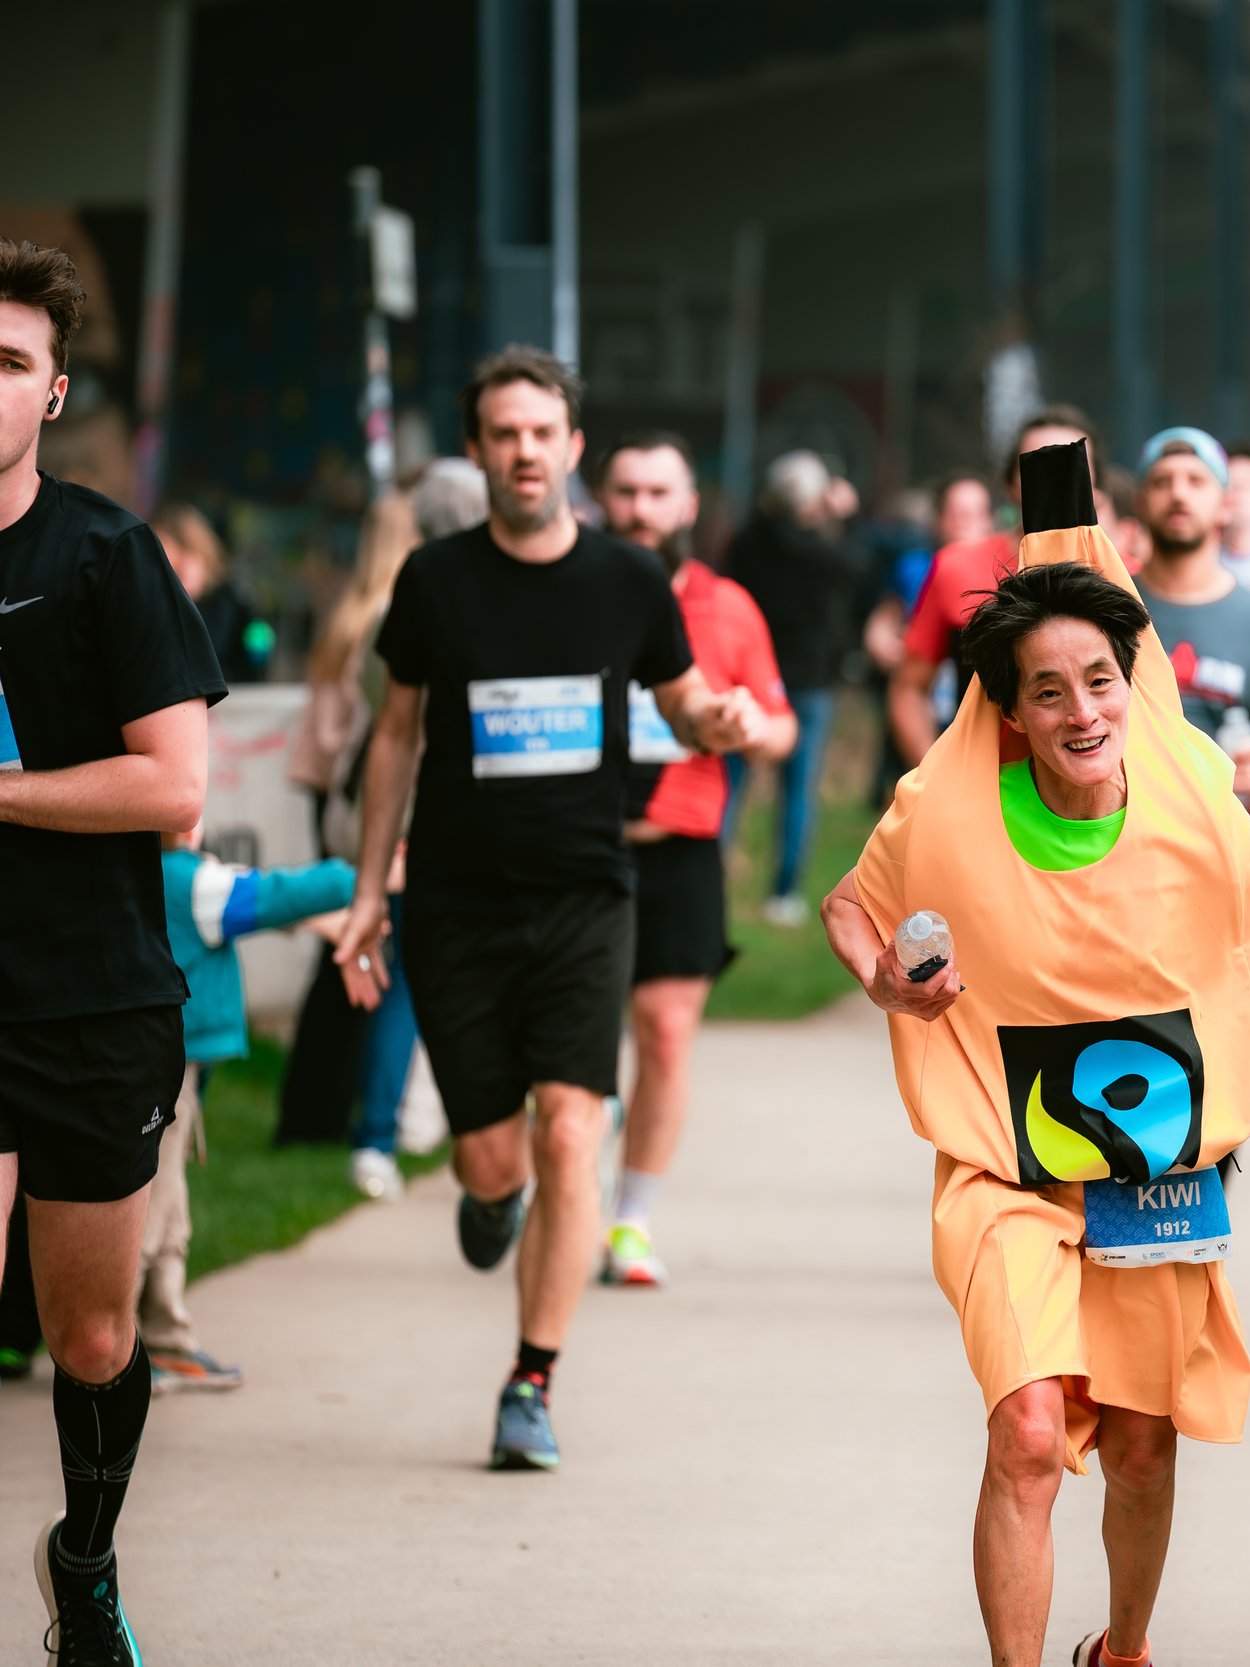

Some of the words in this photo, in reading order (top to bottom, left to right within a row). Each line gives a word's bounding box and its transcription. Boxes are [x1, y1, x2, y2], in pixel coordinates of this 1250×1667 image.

[484, 709, 588, 736] WOUTER
[1137, 1181, 1201, 1210] KIWI
[1154, 1220, 1191, 1236] 1912
